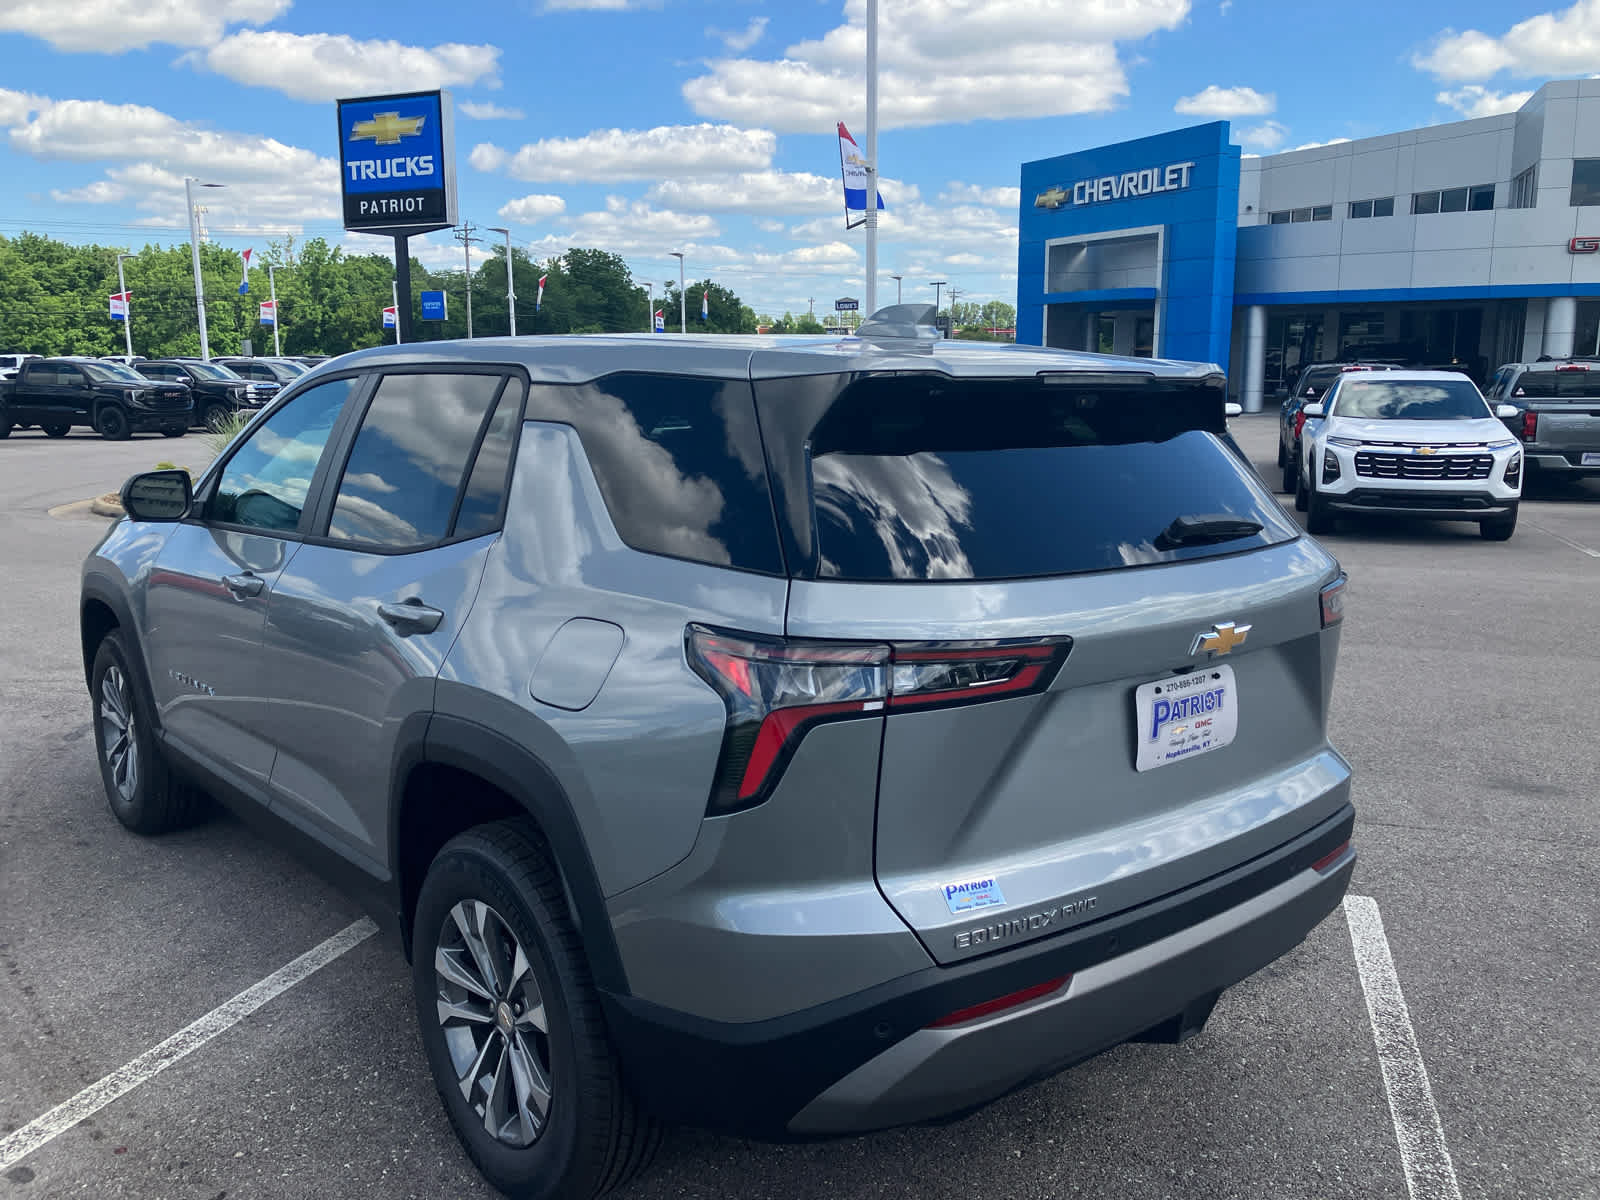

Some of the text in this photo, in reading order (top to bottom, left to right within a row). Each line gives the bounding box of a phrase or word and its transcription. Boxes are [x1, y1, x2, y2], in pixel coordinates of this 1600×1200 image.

[347, 155, 434, 180] TRUCKS
[1073, 162, 1195, 205] CHEVROLET
[360, 197, 424, 214] PATRIOT
[1152, 688, 1224, 739] PATRIOT
[1194, 718, 1213, 729] GMC
[945, 879, 993, 900] PATRIOT
[954, 909, 1057, 949] EQUINOX
